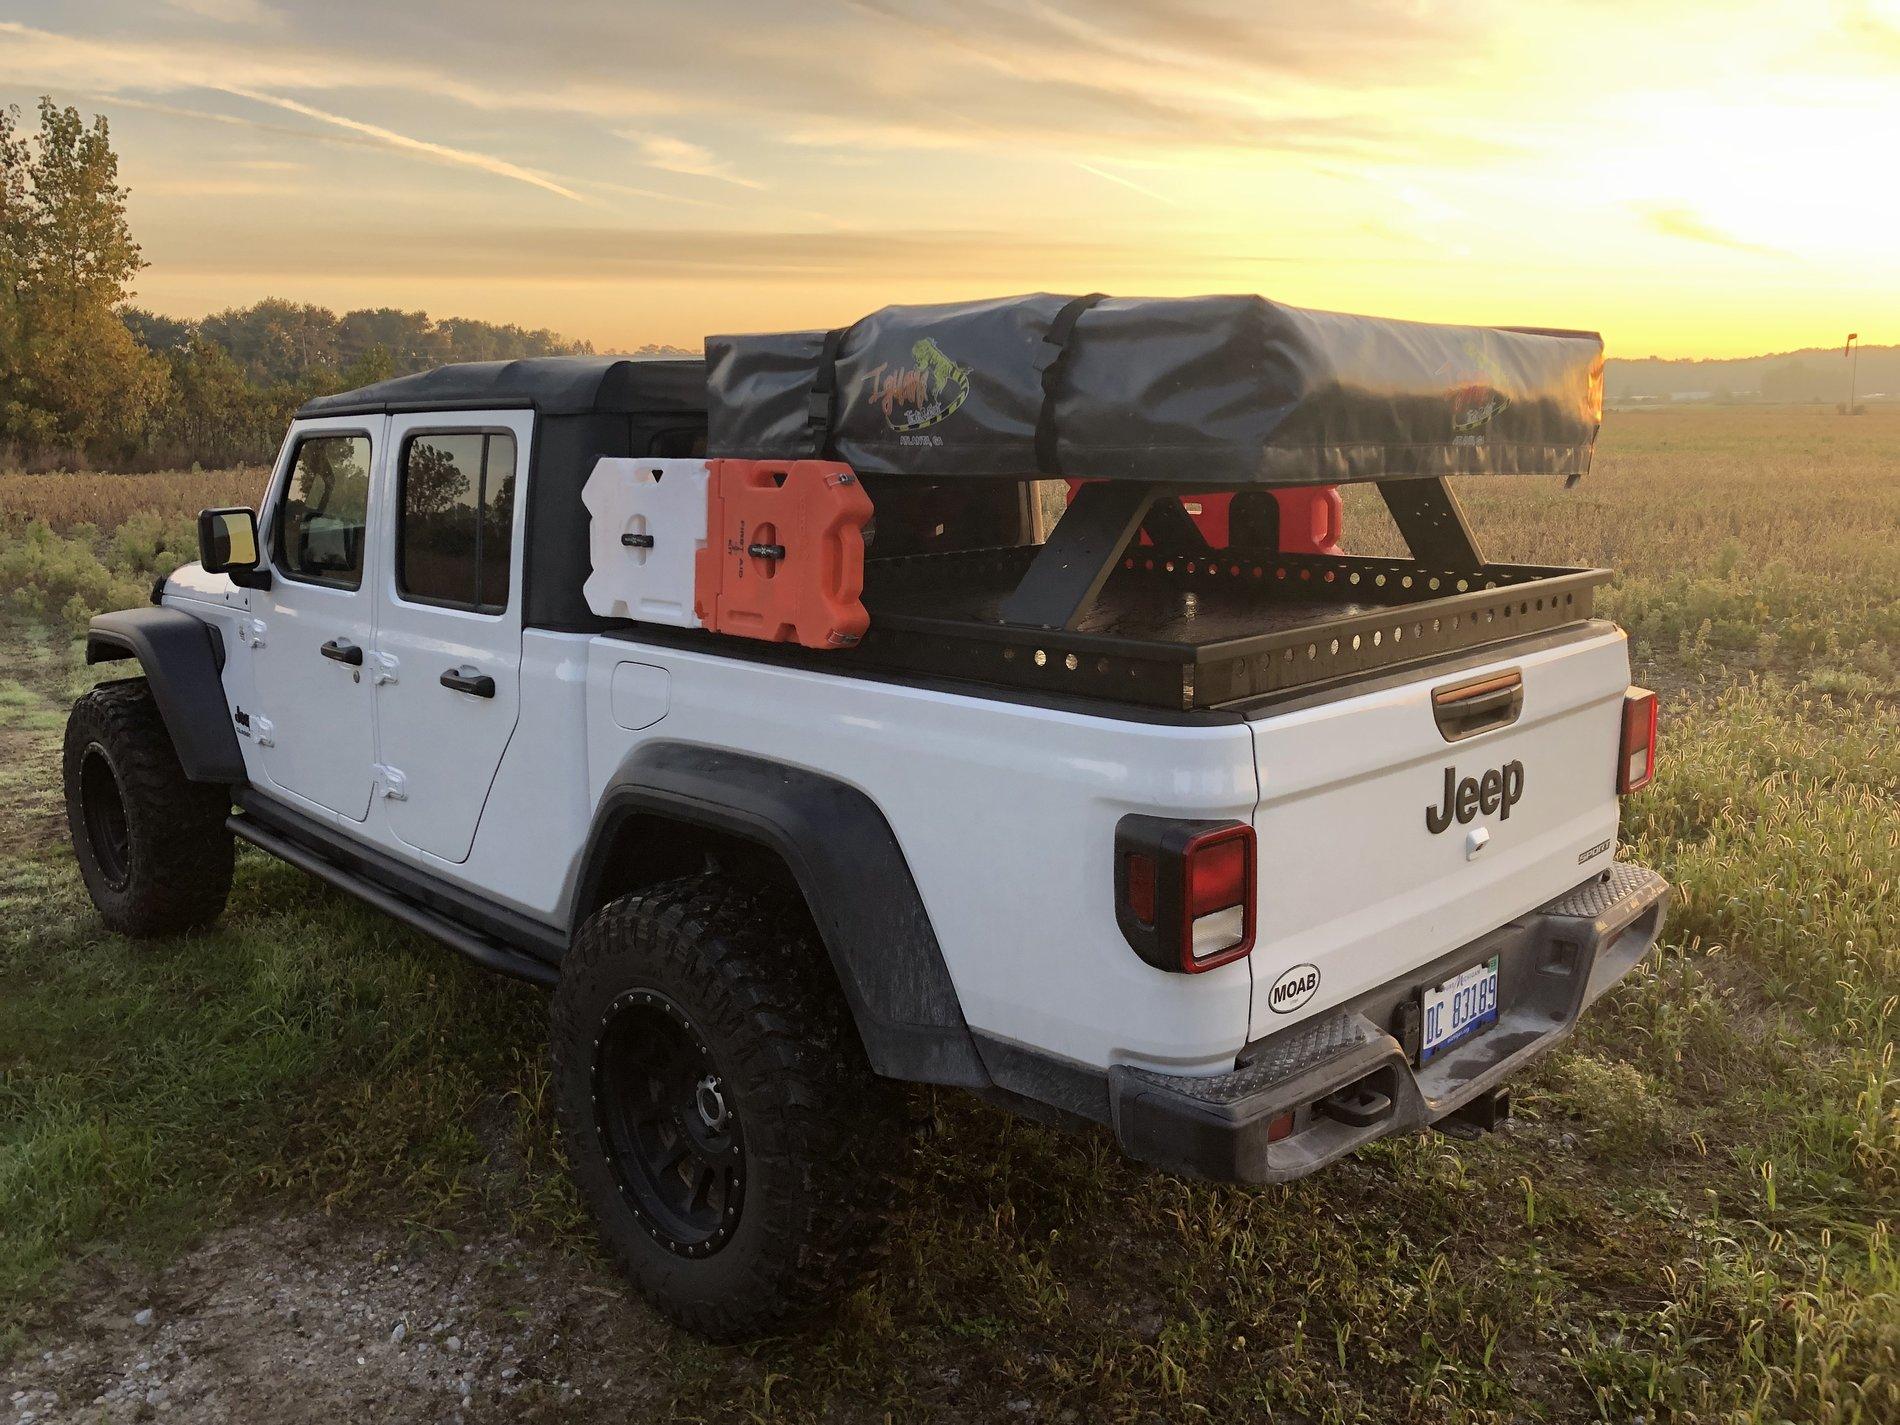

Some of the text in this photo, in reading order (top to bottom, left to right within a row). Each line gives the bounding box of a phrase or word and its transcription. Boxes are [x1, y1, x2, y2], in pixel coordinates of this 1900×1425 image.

[1426, 759, 1524, 834] Jeep
[1273, 972, 1316, 1005] MOAB
[1427, 974, 1496, 1045] DC 83189
